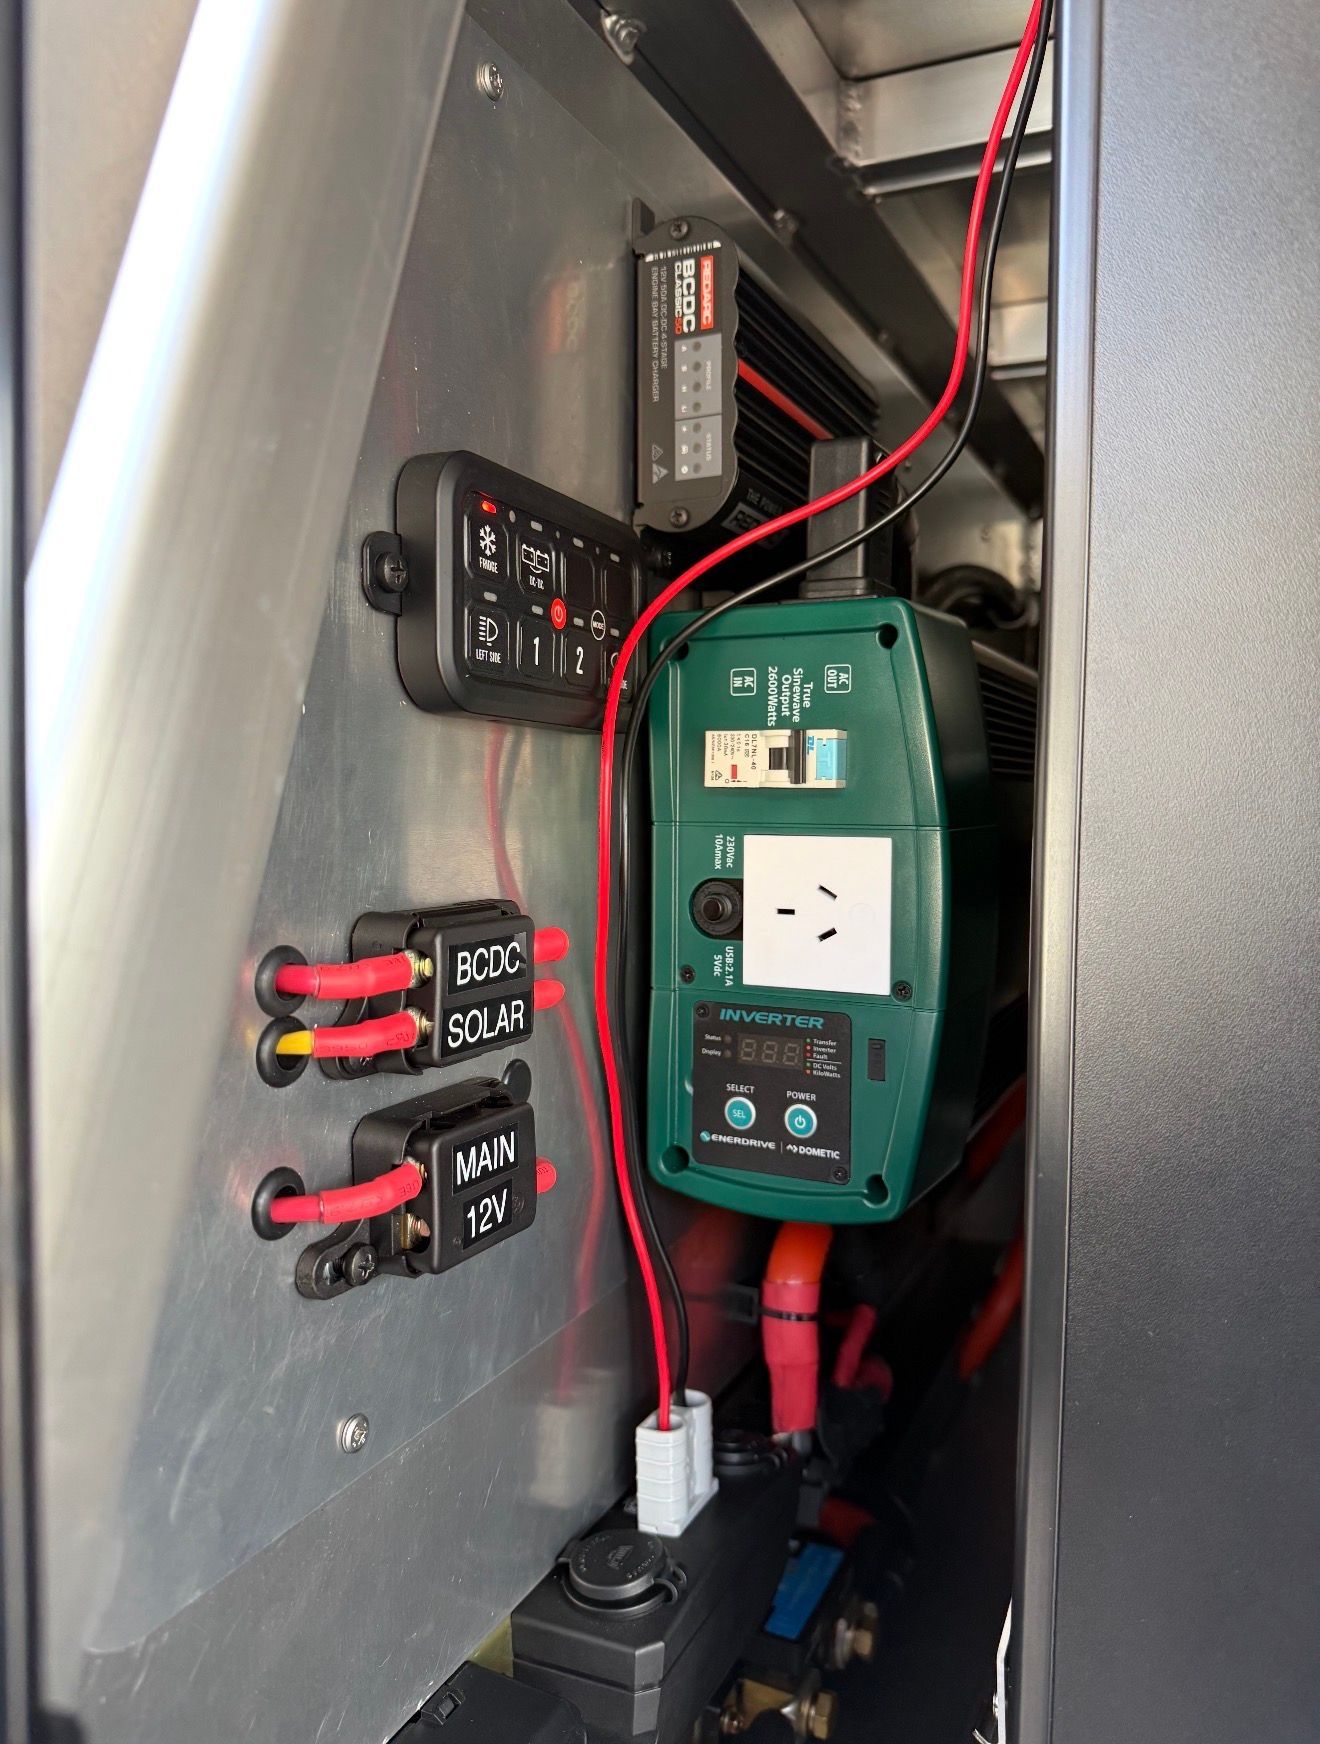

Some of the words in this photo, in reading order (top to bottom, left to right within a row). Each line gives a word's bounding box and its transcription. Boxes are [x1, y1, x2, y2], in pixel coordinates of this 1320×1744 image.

[682, 259, 695, 333] BCDC
[703, 260, 711, 324] REDARC
[479, 556, 498, 574] FRIDGE
[529, 575, 545, 590] DC-DC
[592, 620, 604, 630] MODE
[476, 648, 488, 662] LEFT
[489, 650, 501, 664] SIDE
[533, 636, 540, 666] 1
[576, 646, 584, 675] 2
[733, 677, 742, 687] IN
[744, 676, 753, 687] AC
[827, 670, 837, 688] OUT
[839, 673, 848, 685] AC
[768, 666, 778, 726] 2600Watts
[780, 675, 791, 716] Output
[793, 668, 803, 722] Sinewave
[804, 682, 813, 708] True
[714, 834, 723, 869] 10Amax
[726, 836, 734, 867] 230Vac
[456, 942, 520, 986] BCDC
[714, 954, 722, 976] 5Vdc
[725, 946, 733, 986] USB:2.1A
[448, 1000, 524, 1048] SOLAR
[720, 1008, 824, 1029] INVERTER
[702, 1048, 721, 1057] Display
[813, 1070, 840, 1078] KiloWatts
[726, 1084, 754, 1093] SELECT
[786, 1091, 816, 1101] POWER
[733, 1110, 746, 1118] SEL
[711, 1134, 776, 1149] ENERDRIVE
[456, 1132, 515, 1186] MAIN
[799, 1147, 840, 1159] DOMETIC
[466, 1188, 508, 1238] 12V
